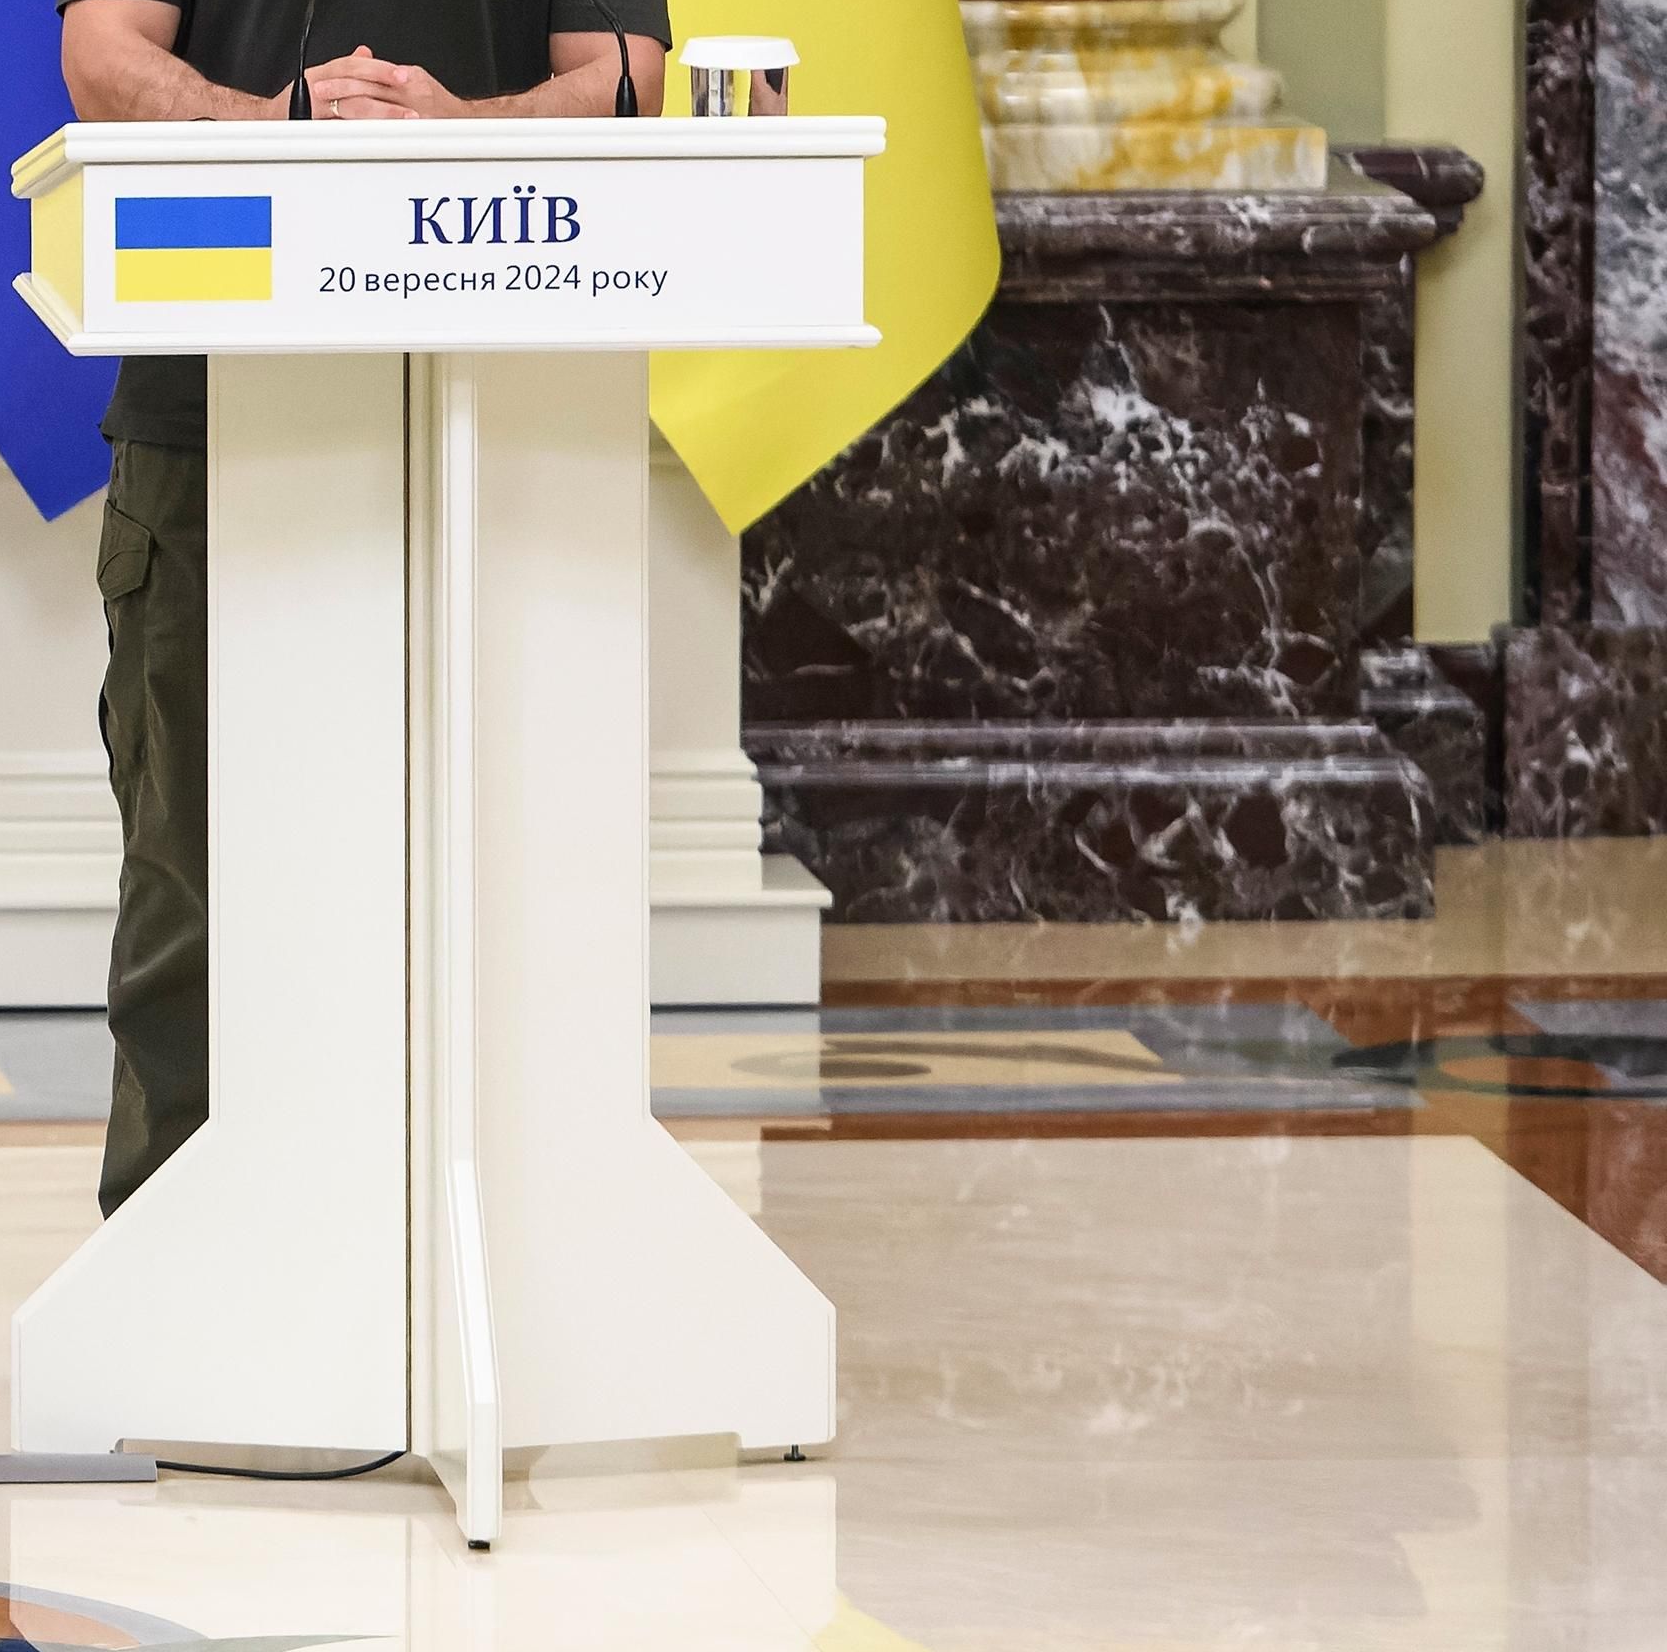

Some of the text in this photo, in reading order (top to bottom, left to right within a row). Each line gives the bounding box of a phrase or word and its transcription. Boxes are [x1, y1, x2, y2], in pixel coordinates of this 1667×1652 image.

[406, 183, 582, 246] КИЇВ
[318, 263, 669, 301] 20 вересня 2024 року
